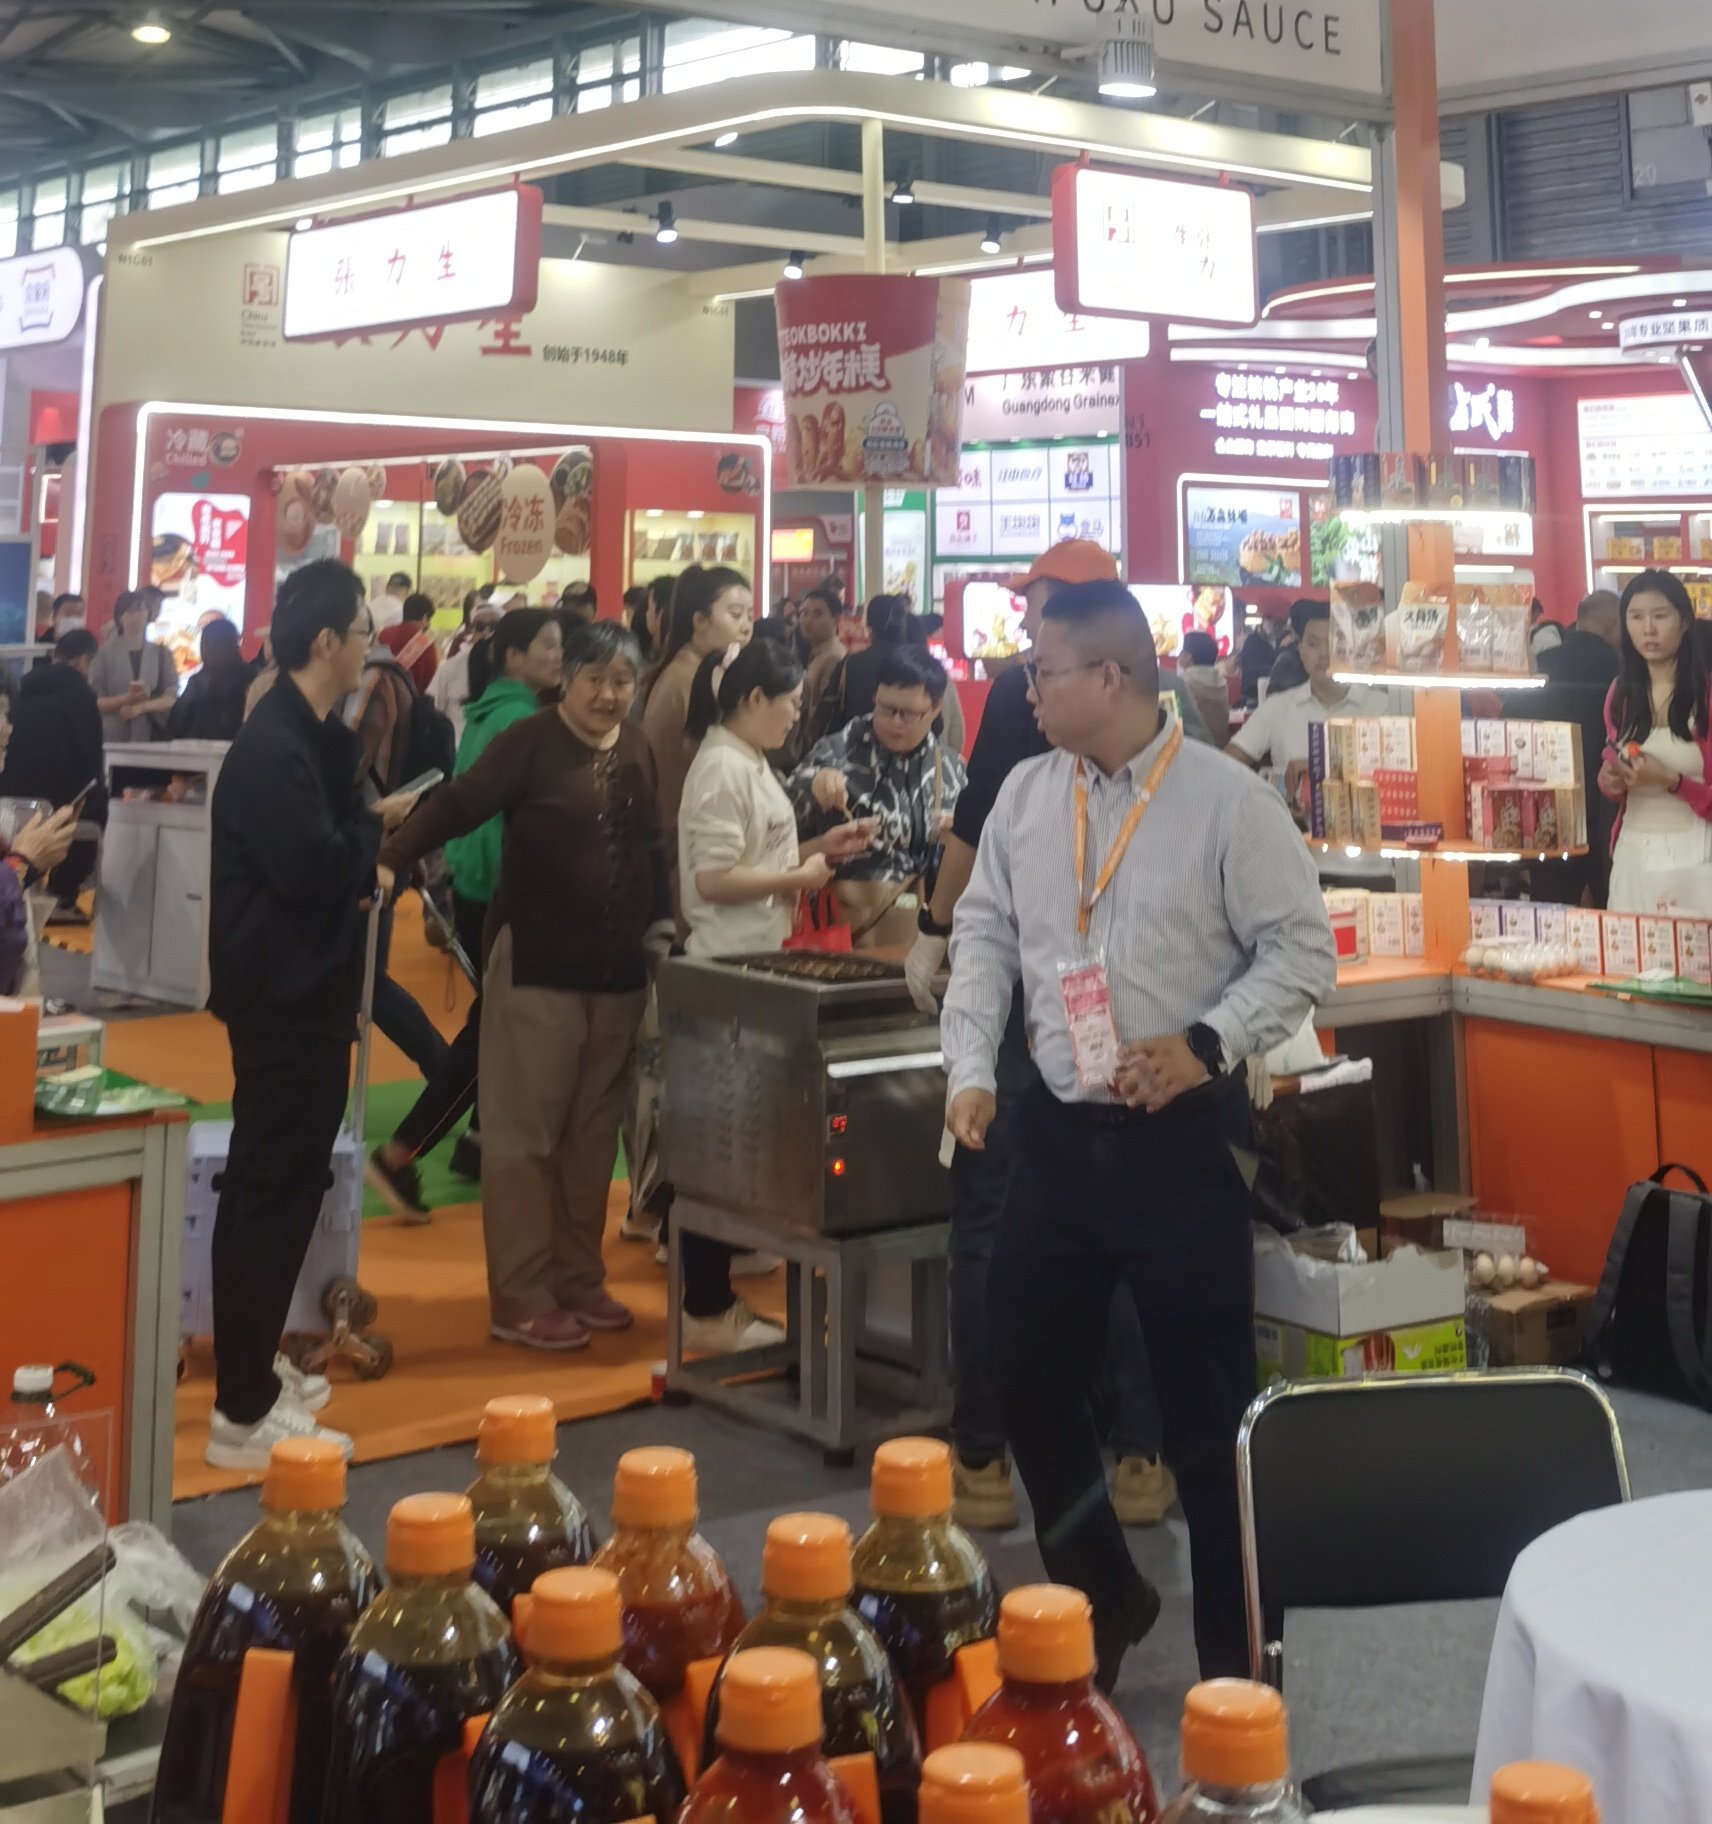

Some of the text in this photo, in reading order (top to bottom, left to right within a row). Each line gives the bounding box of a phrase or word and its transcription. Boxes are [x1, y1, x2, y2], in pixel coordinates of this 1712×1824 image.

[543, 343, 630, 367] 创始于1948年
[1002, 395, 1071, 417] Guangdong
